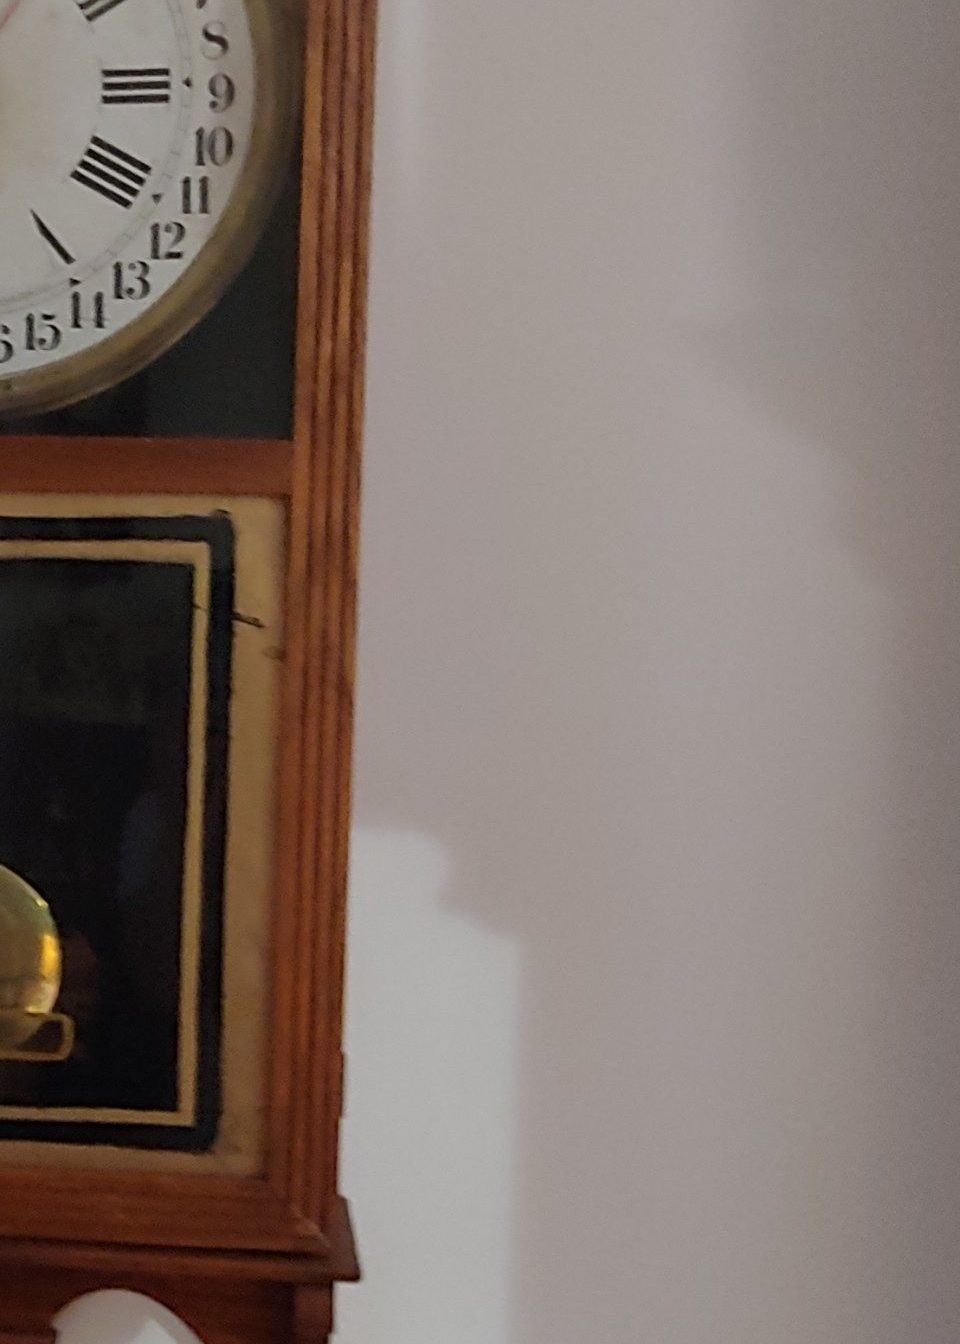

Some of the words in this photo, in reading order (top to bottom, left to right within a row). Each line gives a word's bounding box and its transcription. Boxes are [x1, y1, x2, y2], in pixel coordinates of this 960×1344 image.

[202, 20, 229, 60] 8
[101, 68, 170, 104] III
[208, 73, 235, 113] 9
[195, 126, 233, 167] 10
[70, 135, 151, 209] IIII
[182, 175, 210, 214] 11
[150, 222, 186, 259] 12
[113, 260, 151, 300] 13
[25, 313, 62, 350] 15
